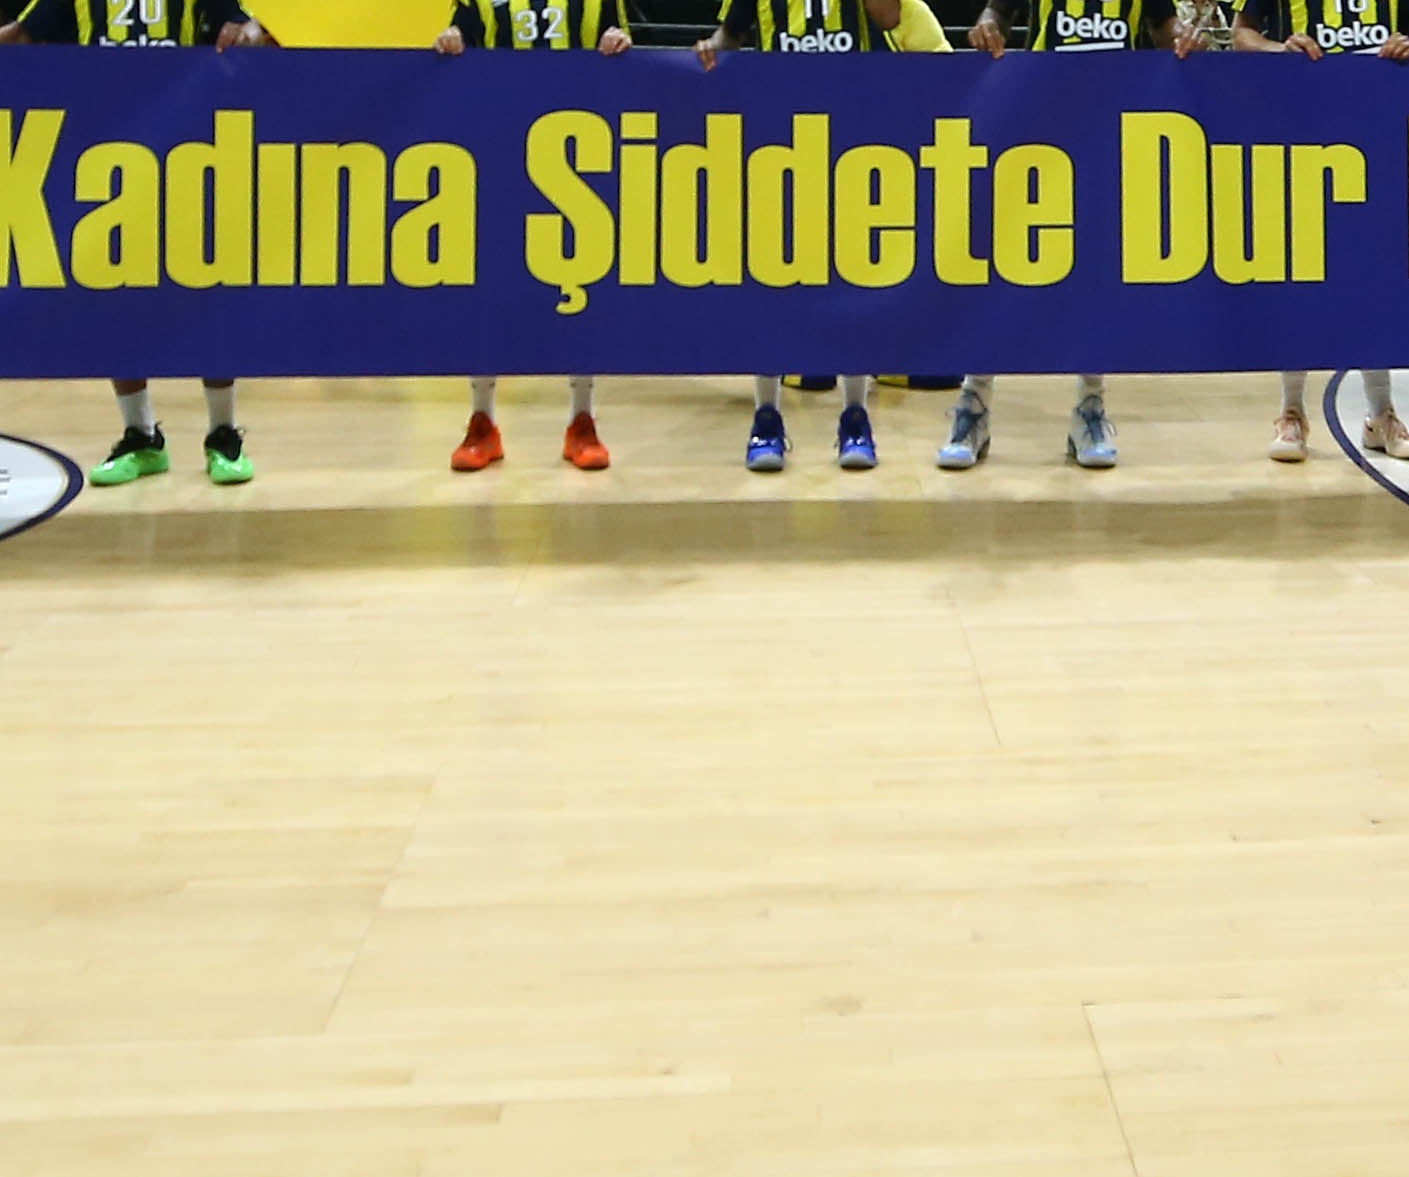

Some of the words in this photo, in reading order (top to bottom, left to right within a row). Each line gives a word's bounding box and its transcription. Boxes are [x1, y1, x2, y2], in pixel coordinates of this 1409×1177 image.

[515, 8, 564, 42] 32
[1056, 11, 1128, 40] beko
[1316, 21, 1389, 48] beko
[525, 110, 1075, 315] Şiddete
[1121, 111, 1366, 285] Dur
